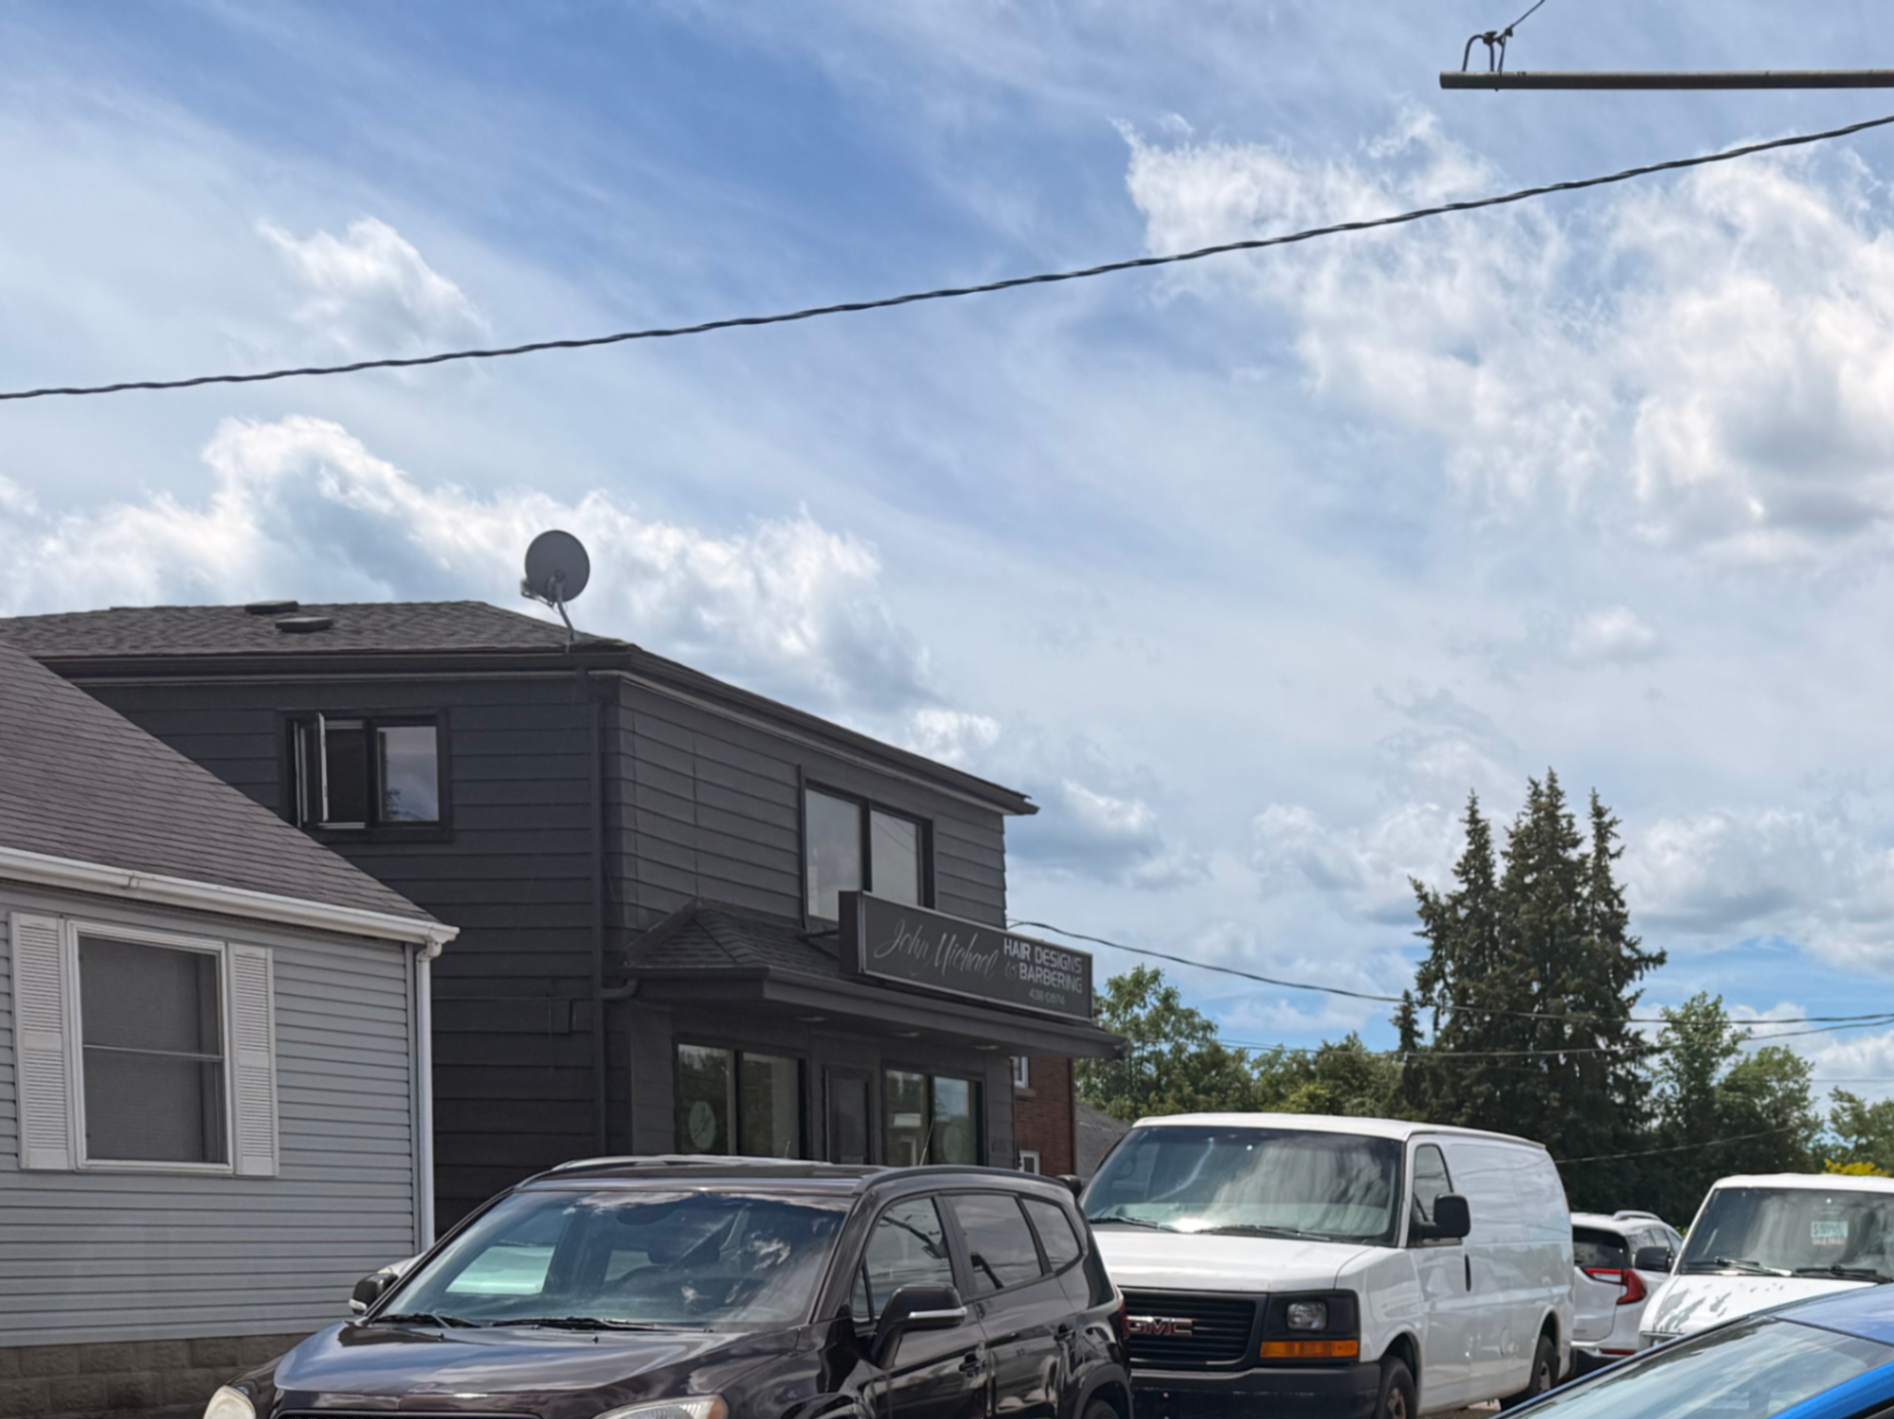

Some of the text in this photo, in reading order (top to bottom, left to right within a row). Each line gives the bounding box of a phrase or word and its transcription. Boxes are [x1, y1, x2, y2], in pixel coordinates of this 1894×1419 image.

[873, 919, 1000, 980] John Michael
[1003, 937, 1082, 974] HAIR DESIGNS
[1019, 962, 1083, 994] BARBERING
[1126, 1315, 1193, 1337] GMC
